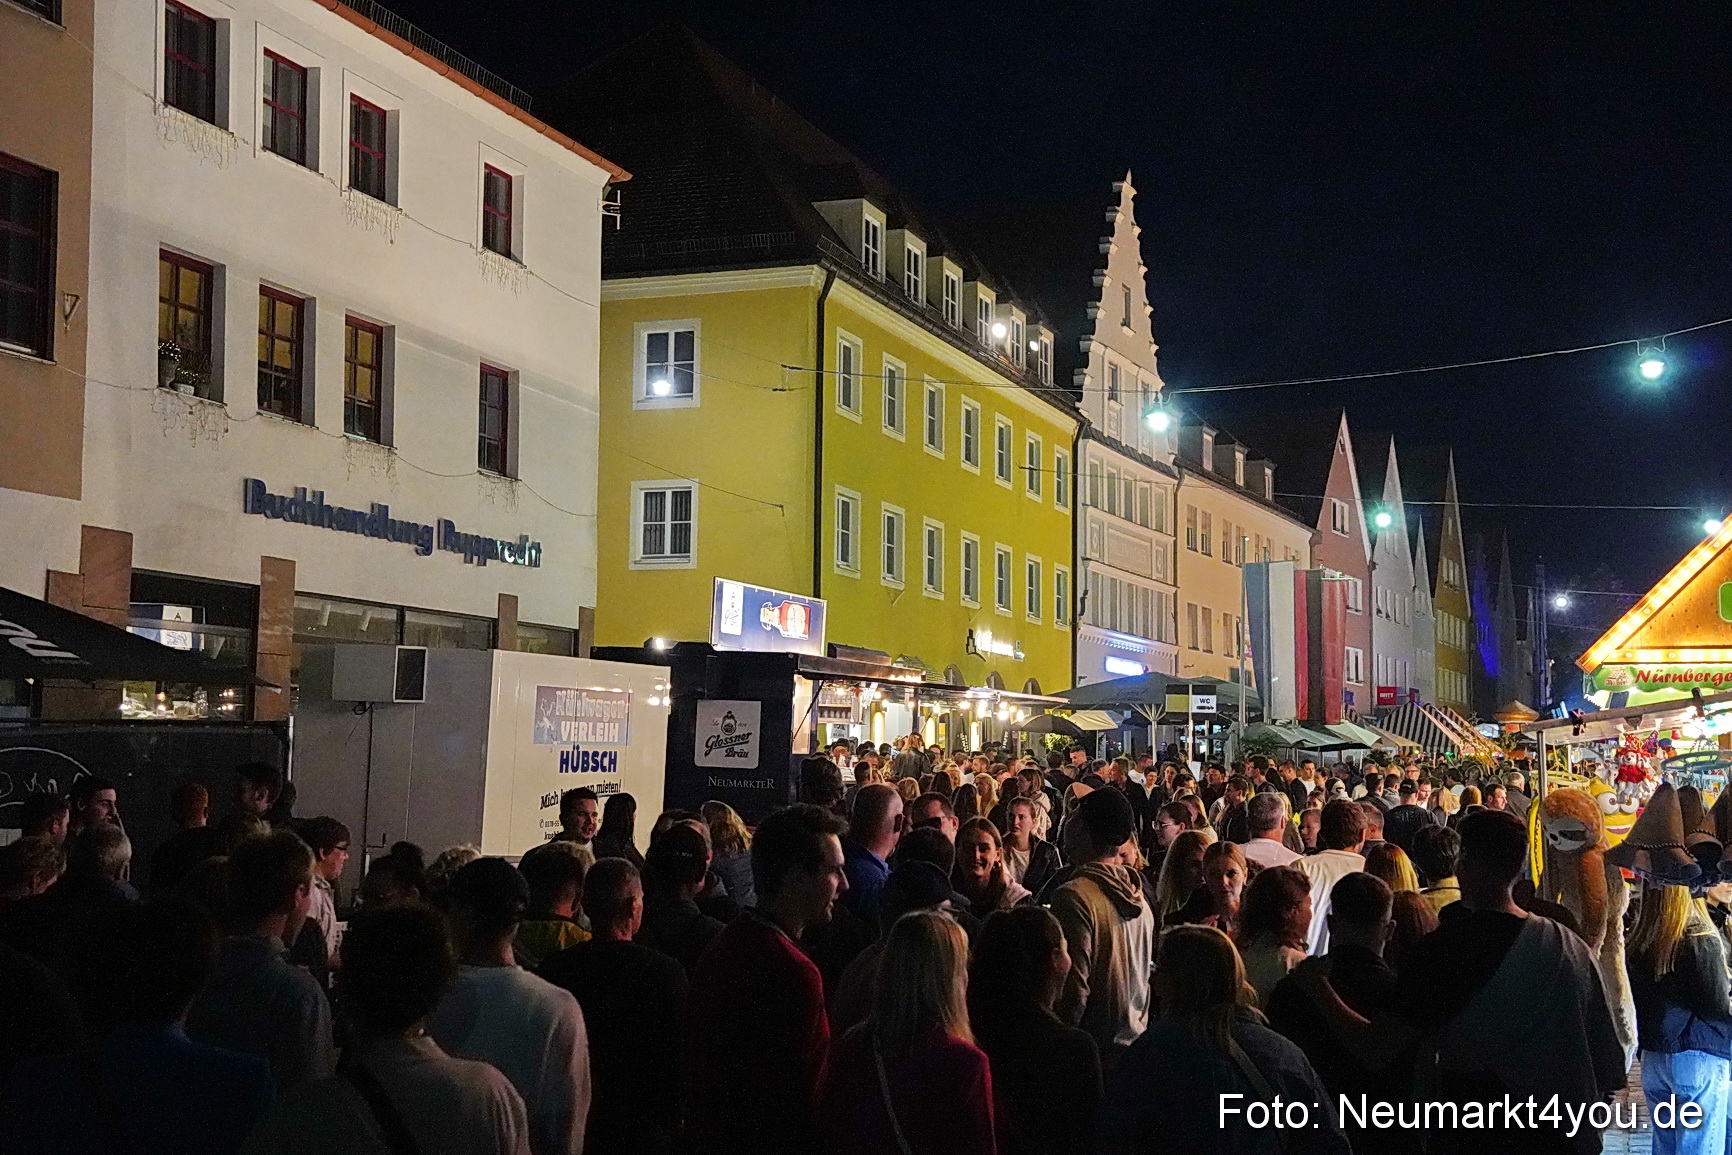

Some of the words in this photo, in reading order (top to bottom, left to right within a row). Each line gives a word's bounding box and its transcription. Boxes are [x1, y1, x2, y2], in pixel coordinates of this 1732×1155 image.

[243, 477, 434, 556] Buchhandlung
[437, 518, 541, 567] Rupprecht
[560, 720, 619, 743] VERLEIH
[703, 731, 753, 758] Glossner
[559, 744, 618, 774] HÜBSCH
[724, 746, 750, 759] Bräu
[539, 790, 560, 810] Mich
[596, 779, 622, 795] mieten!
